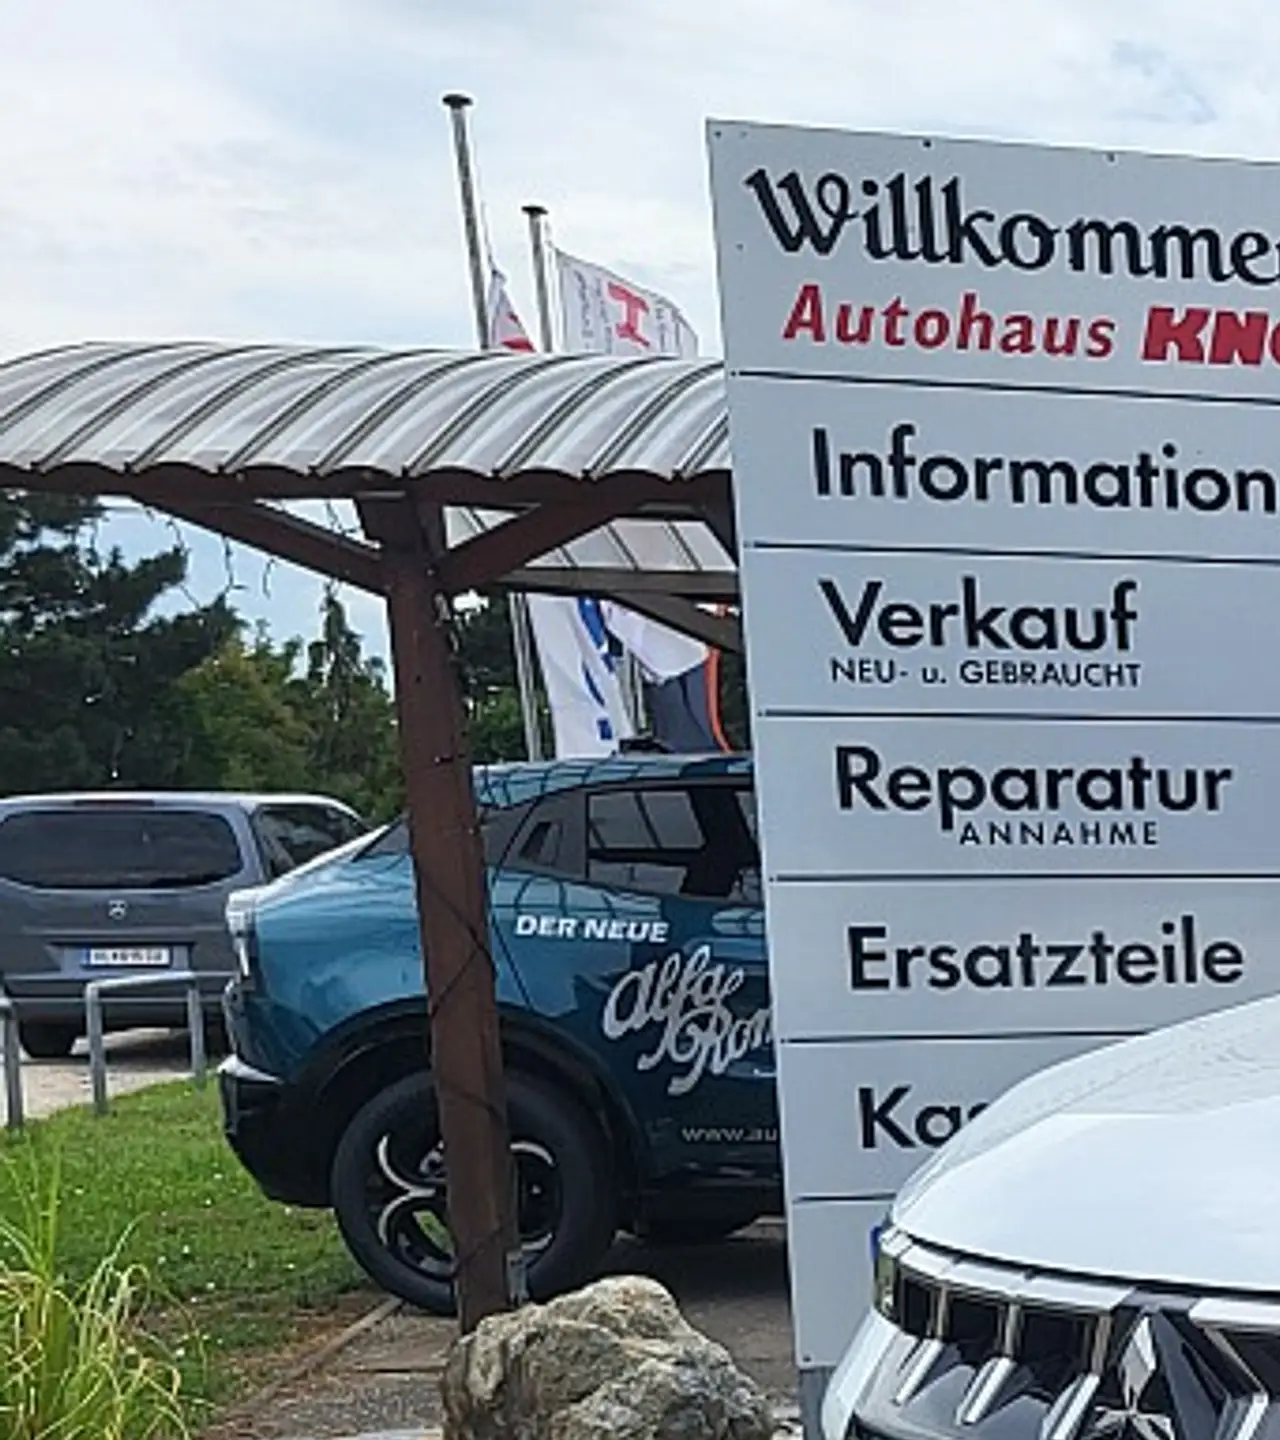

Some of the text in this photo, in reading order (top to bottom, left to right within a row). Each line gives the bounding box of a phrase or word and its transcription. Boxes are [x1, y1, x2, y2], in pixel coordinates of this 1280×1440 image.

[783, 284, 1115, 358] Autohaus
[812, 422, 1278, 514] Information
[817, 574, 1139, 653] Verkauf
[829, 656, 1143, 689] NEU- u. GEBRAUCHT
[834, 744, 1234, 832] Reparatur
[957, 819, 1160, 847] ANNAHME
[515, 914, 670, 943] DER NEUE
[846, 913, 1245, 992] Ersatzteile
[857, 1084, 990, 1151] Ka
